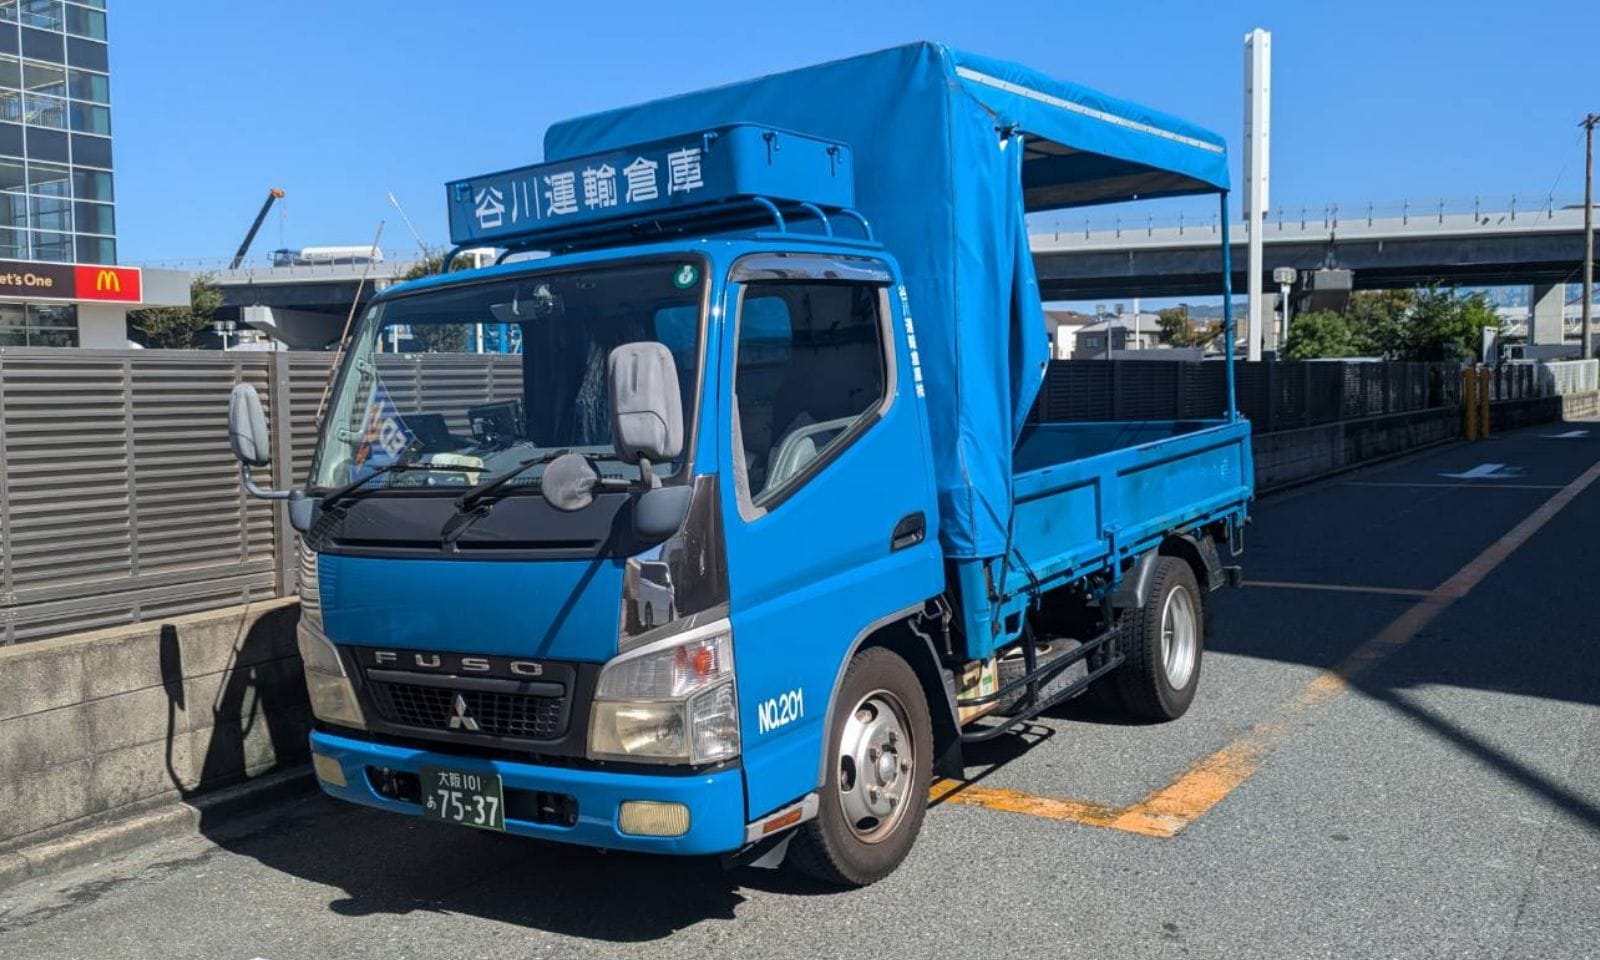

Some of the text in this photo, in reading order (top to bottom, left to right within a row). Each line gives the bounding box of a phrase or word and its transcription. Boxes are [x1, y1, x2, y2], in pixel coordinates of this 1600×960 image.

[475, 147, 704, 229] 谷川運輸倉庫
[24, 273, 53, 287] One
[375, 650, 543, 676] FUSO
[438, 789, 498, 827] 75-37
